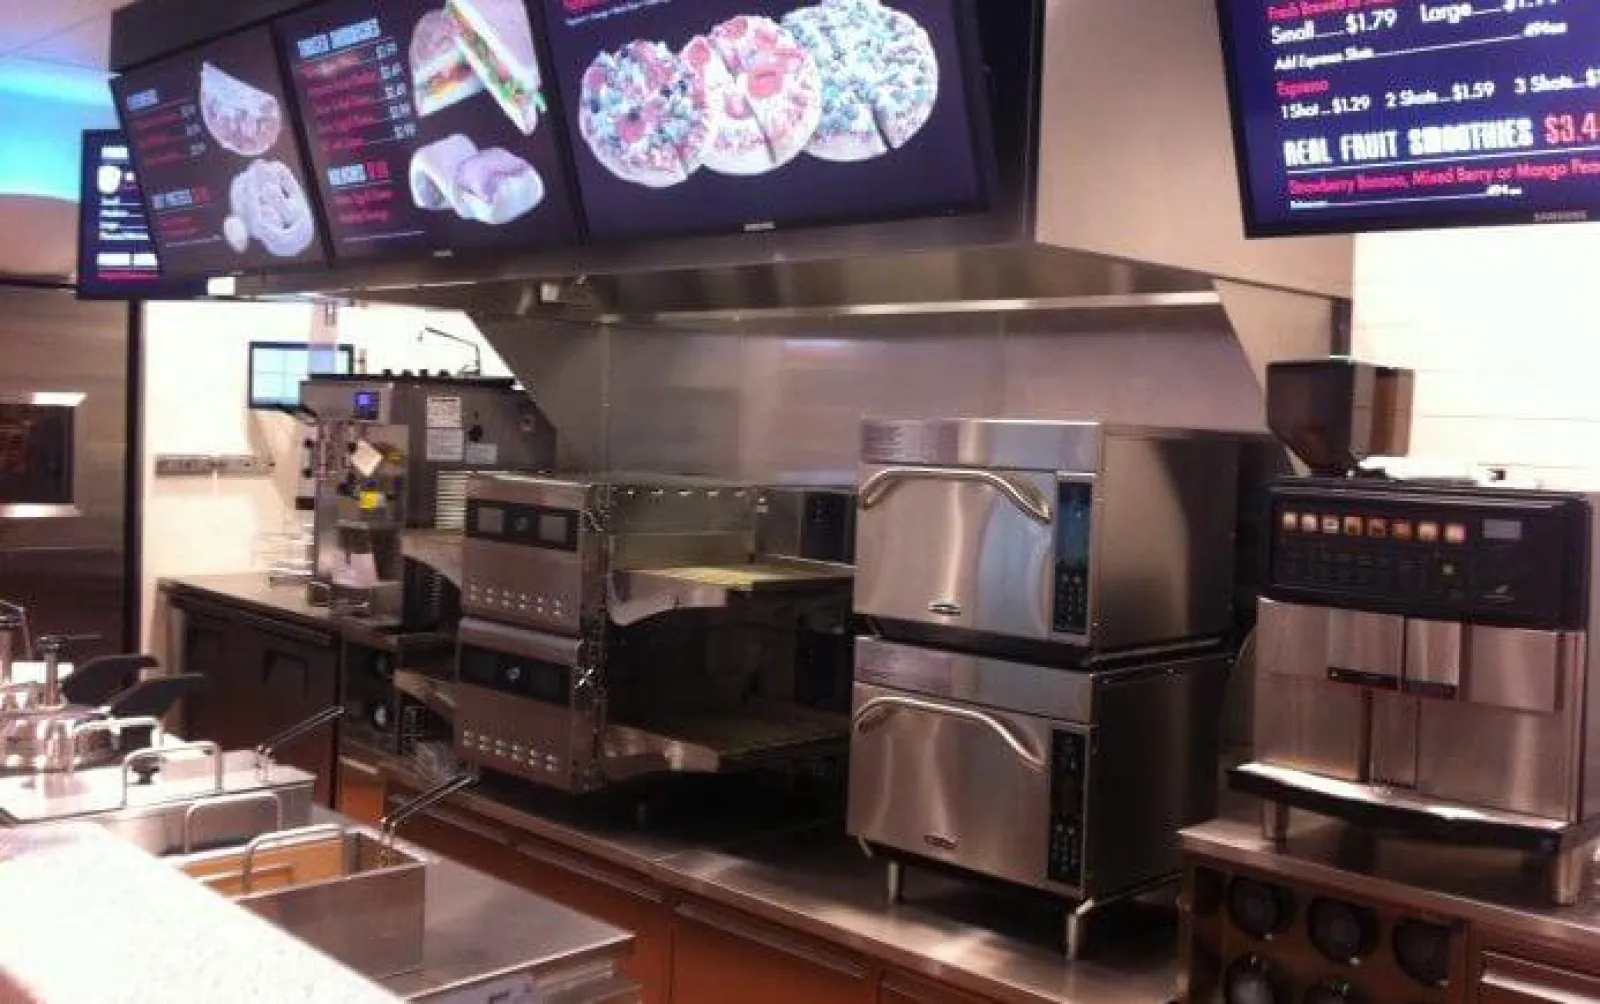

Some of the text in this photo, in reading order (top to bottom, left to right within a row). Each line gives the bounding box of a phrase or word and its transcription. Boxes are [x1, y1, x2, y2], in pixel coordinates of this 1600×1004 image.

[1421, 4, 1473, 23] Large
[1271, 8, 1398, 44] Small $1.79
[1384, 81, 1495, 108] 2 Shots $1.59
[1514, 76, 1527, 94] 3
[1530, 74, 1573, 92] Shots
[1289, 102, 1319, 118] Shot
[1331, 95, 1371, 113] $1.29
[1283, 137, 1332, 166] REAL
[1339, 130, 1398, 161] FRUIT
[1408, 118, 1534, 155] SMOOTHIES
[1456, 166, 1493, 183] Berry
[1496, 168, 1511, 179] or
[1516, 162, 1568, 180] Mango
